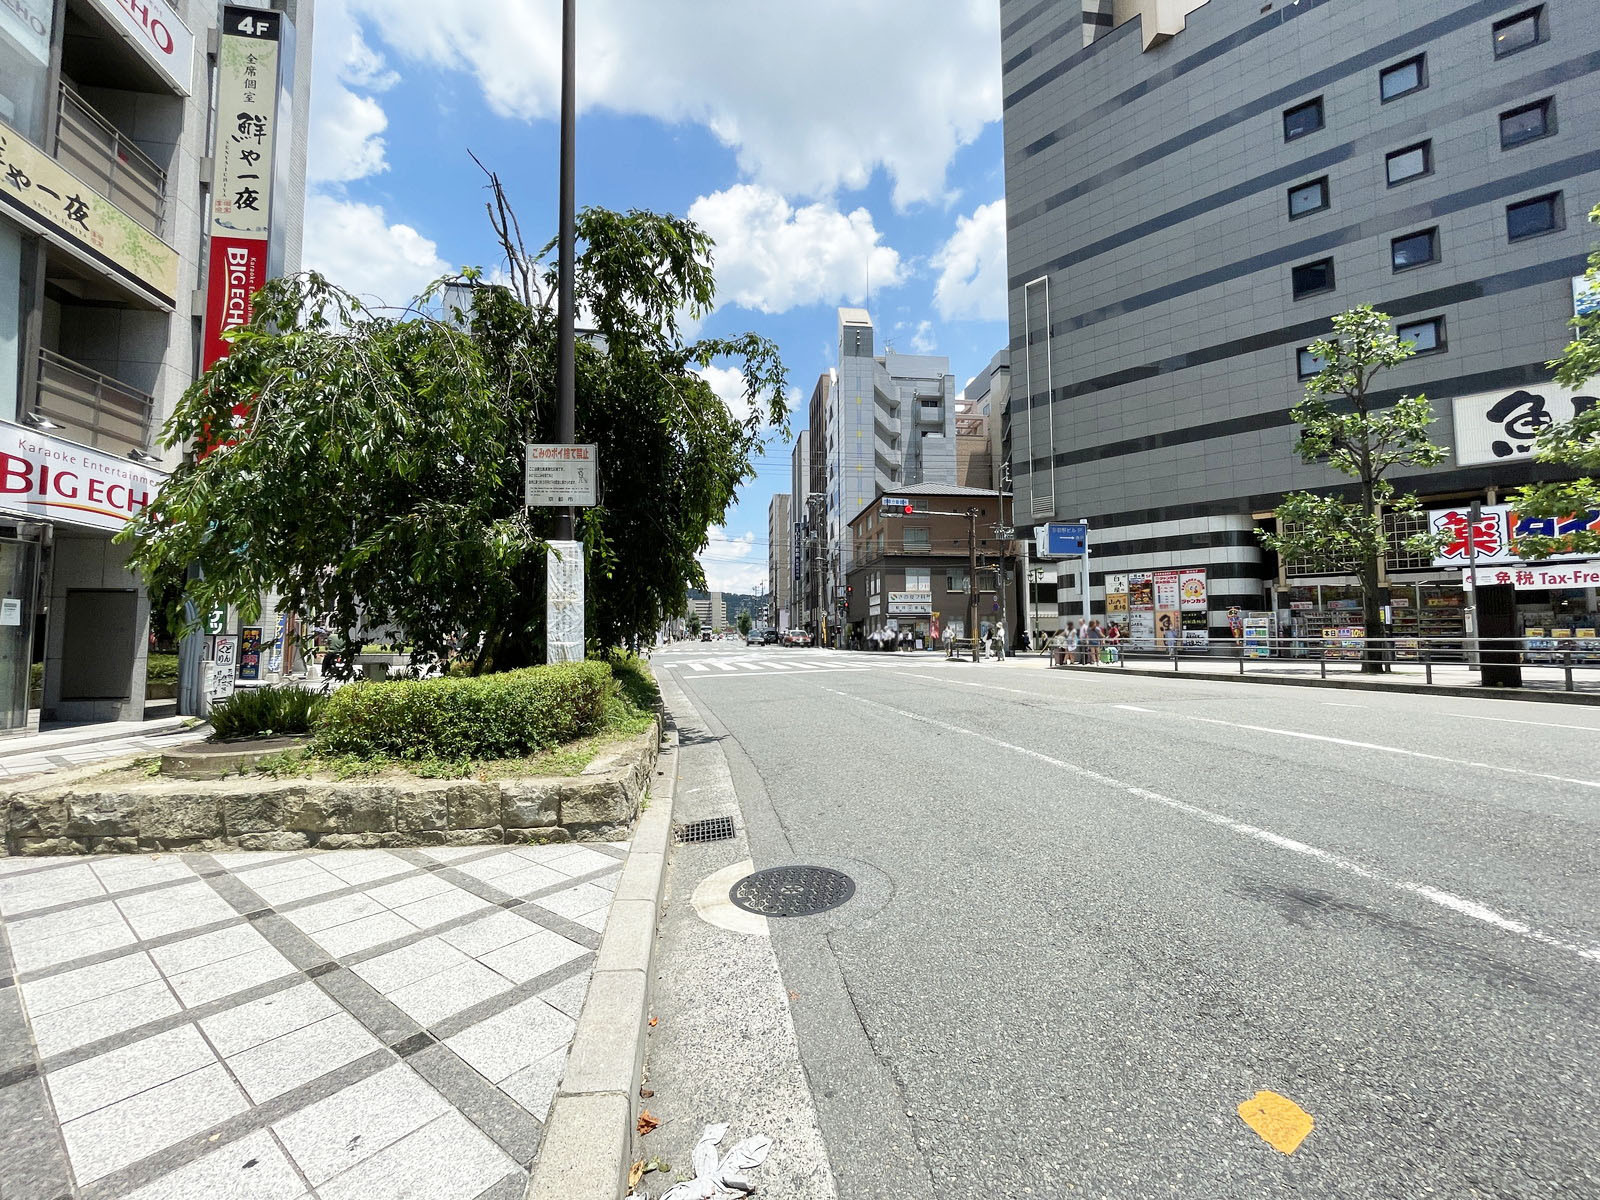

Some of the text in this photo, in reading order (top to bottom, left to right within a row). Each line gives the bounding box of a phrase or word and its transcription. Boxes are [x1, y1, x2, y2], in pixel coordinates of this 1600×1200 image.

[7, 0, 47, 36] HO
[120, 0, 174, 55] HO
[237, 16, 270, 36] 4F
[243, 53, 258, 104] 全席個室
[232, 112, 268, 212] 鮮や一夜
[227, 247, 249, 285] BIG
[249, 257, 257, 284] Karaoke
[18, 439, 159, 487] Karaoke Entertainme
[532, 447, 590, 459] ごみのポイ捨て禁止
[0, 452, 160, 521] BIG ECH
[1434, 511, 1502, 559] 薬
[1494, 570, 1534, 586] 免税
